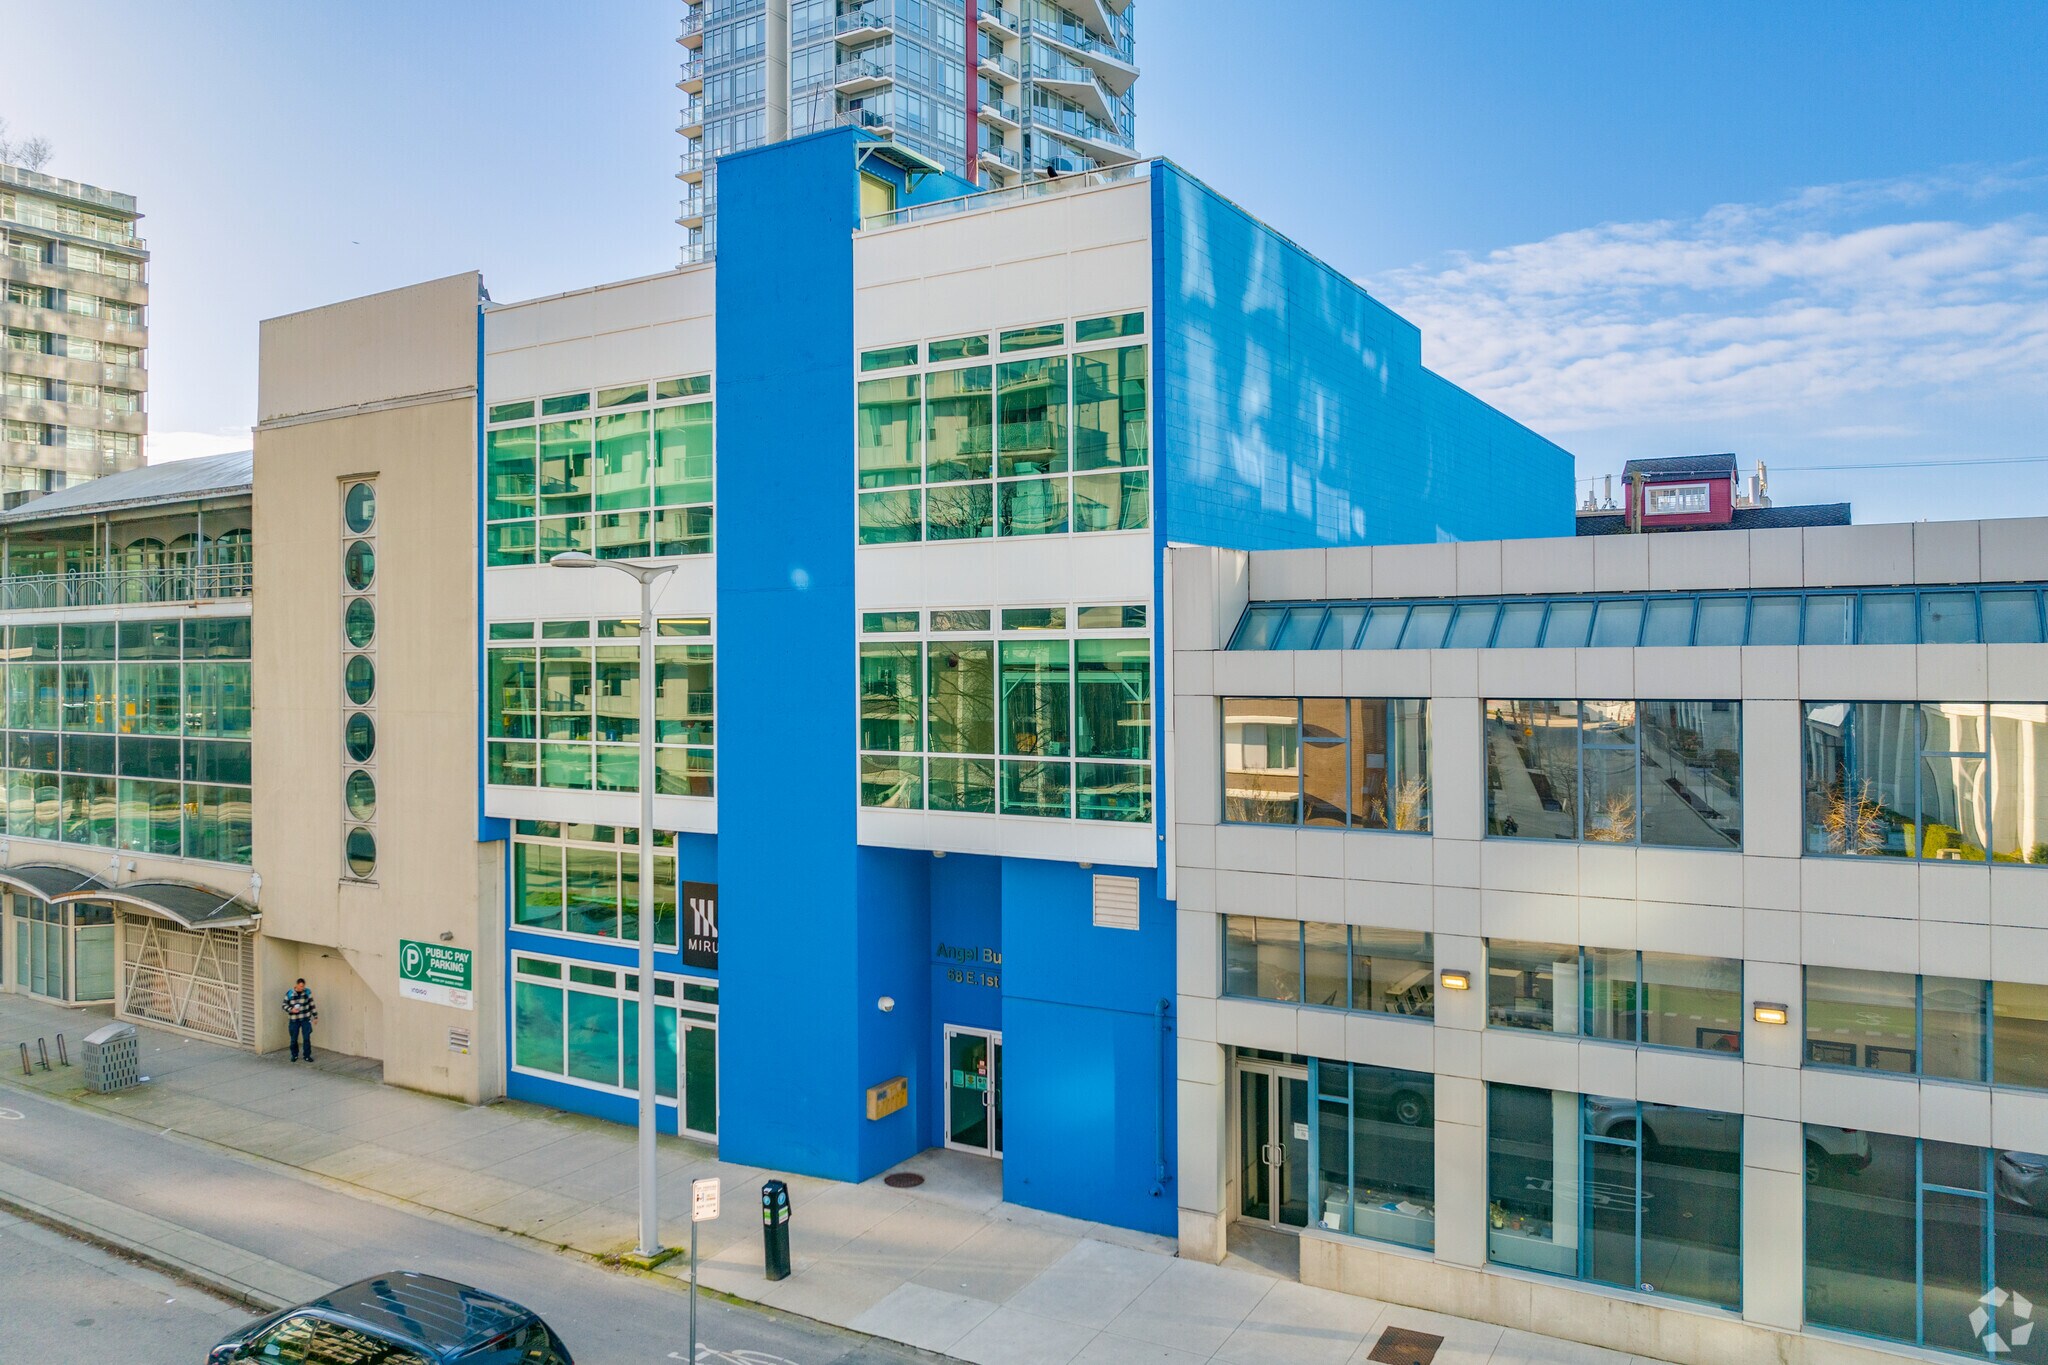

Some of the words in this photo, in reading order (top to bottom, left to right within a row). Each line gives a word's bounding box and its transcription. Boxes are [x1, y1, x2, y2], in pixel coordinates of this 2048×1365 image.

[407, 948, 419, 971] P
[425, 947, 453, 960] PUBLIC
[454, 952, 469, 963] PAY
[937, 943, 979, 963] Angel
[430, 958, 464, 973] PARKING
[947, 968, 963, 983] 68
